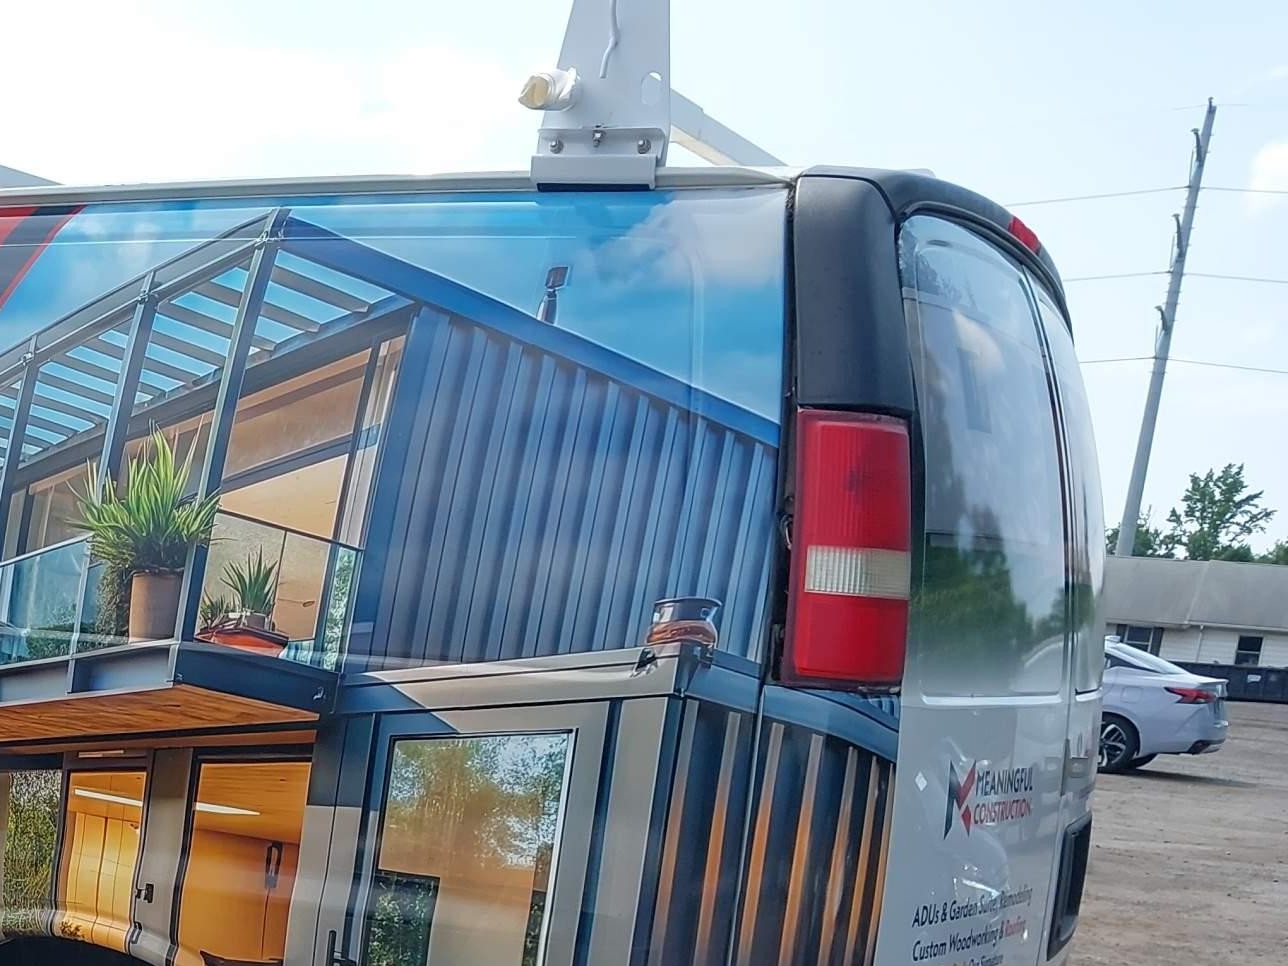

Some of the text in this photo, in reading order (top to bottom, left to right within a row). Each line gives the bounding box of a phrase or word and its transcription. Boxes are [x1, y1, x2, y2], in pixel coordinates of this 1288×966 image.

[975, 767, 1033, 797] MEANINGFUL
[973, 798, 1032, 825] CONSTRUCTION
[912, 903, 940, 928] ADUs
[941, 902, 948, 922] &
[949, 897, 978, 921] Garden
[912, 940, 947, 962] Custom
[949, 923, 998, 948] Woodworking
